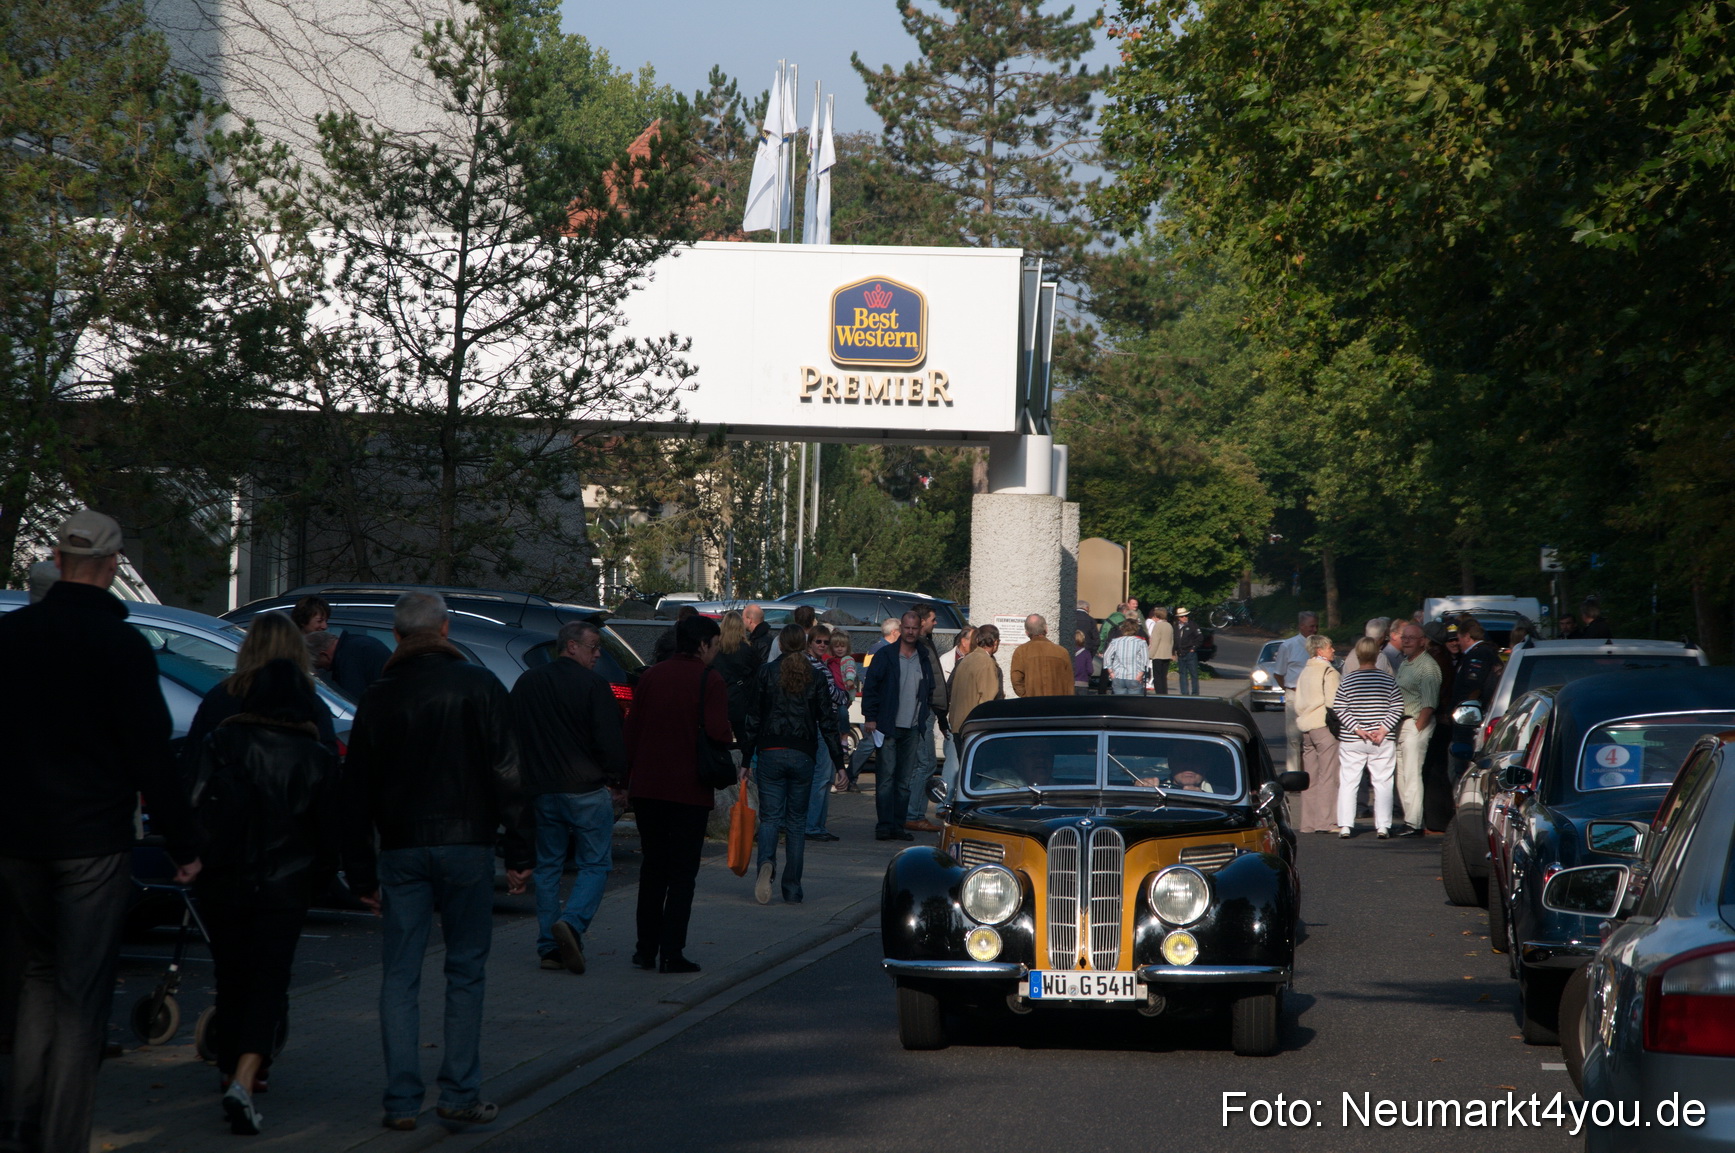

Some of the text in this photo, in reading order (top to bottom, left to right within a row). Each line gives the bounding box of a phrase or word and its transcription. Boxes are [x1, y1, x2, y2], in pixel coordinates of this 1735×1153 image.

[853, 307, 899, 329] Best
[836, 325, 919, 348] Western
[799, 366, 954, 403] PREMIER
[1605, 748, 1618, 764] 4
[1080, 975, 1092, 996] G
